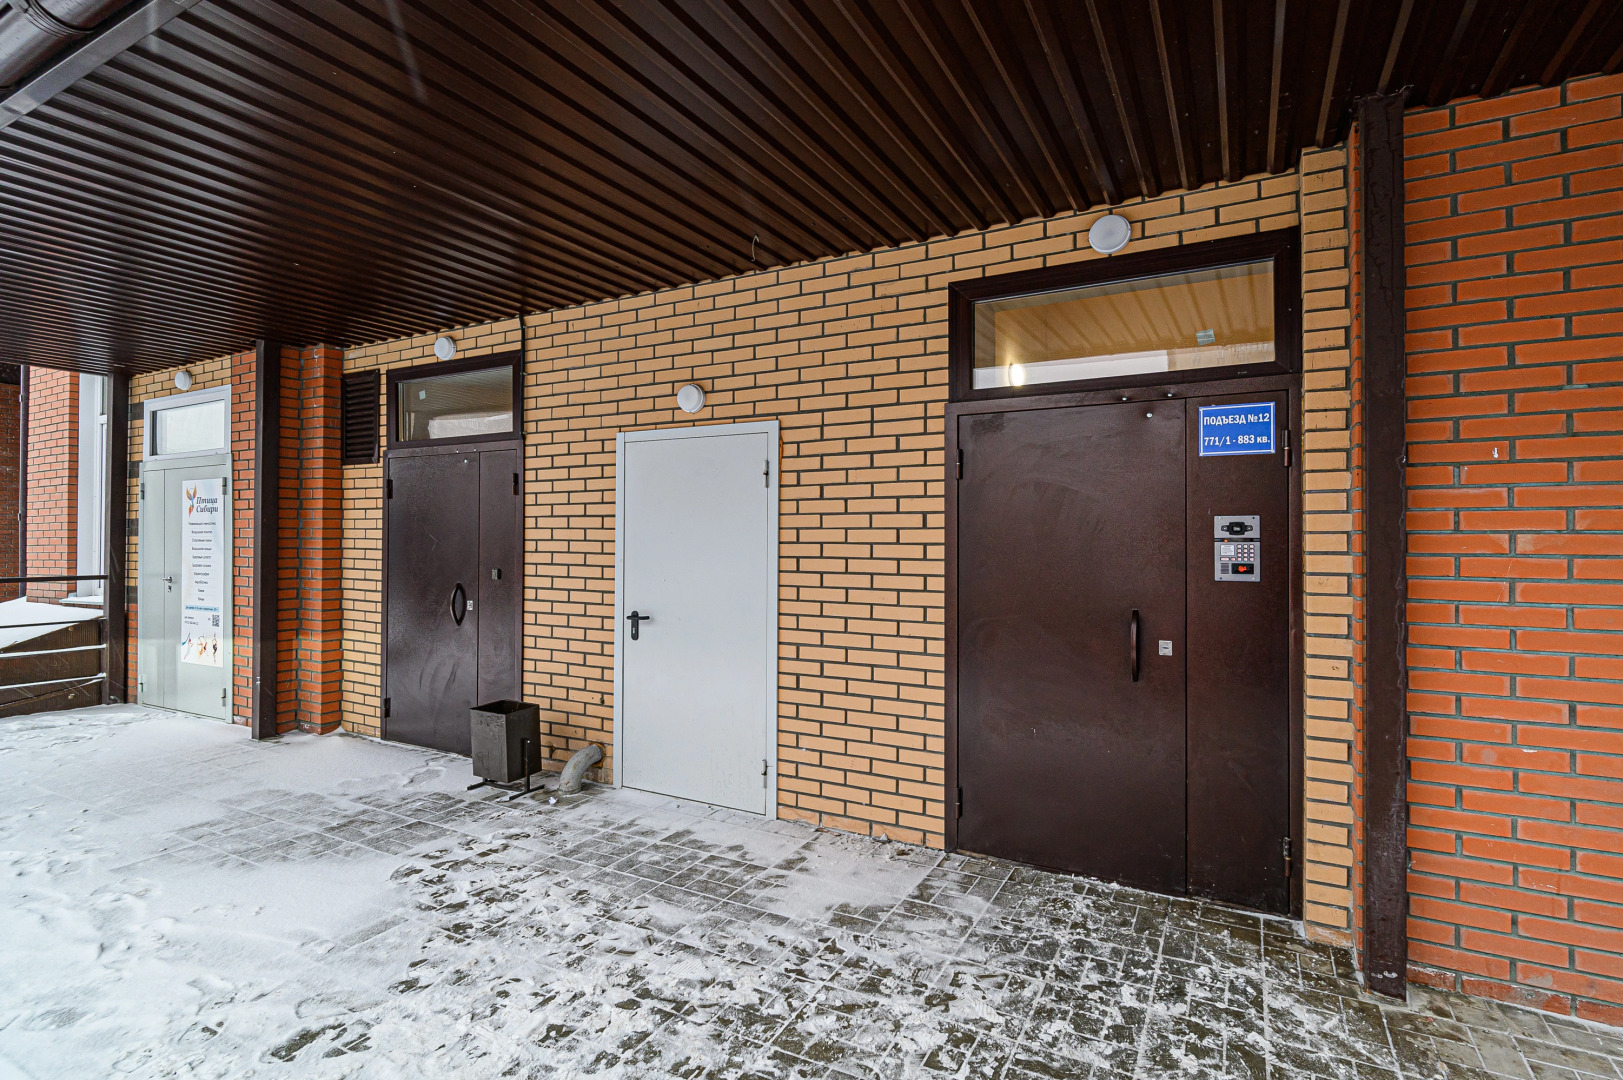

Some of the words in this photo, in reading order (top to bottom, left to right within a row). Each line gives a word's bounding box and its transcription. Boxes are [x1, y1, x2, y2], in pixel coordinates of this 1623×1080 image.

[1203, 414, 1246, 426] ПОДЪЕЗД
[1247, 412, 1270, 423] №12
[1203, 436, 1231, 447] 771/1
[1237, 434, 1255, 445] 883
[1256, 436, 1271, 444] кв.
[196, 496, 218, 506] Птица
